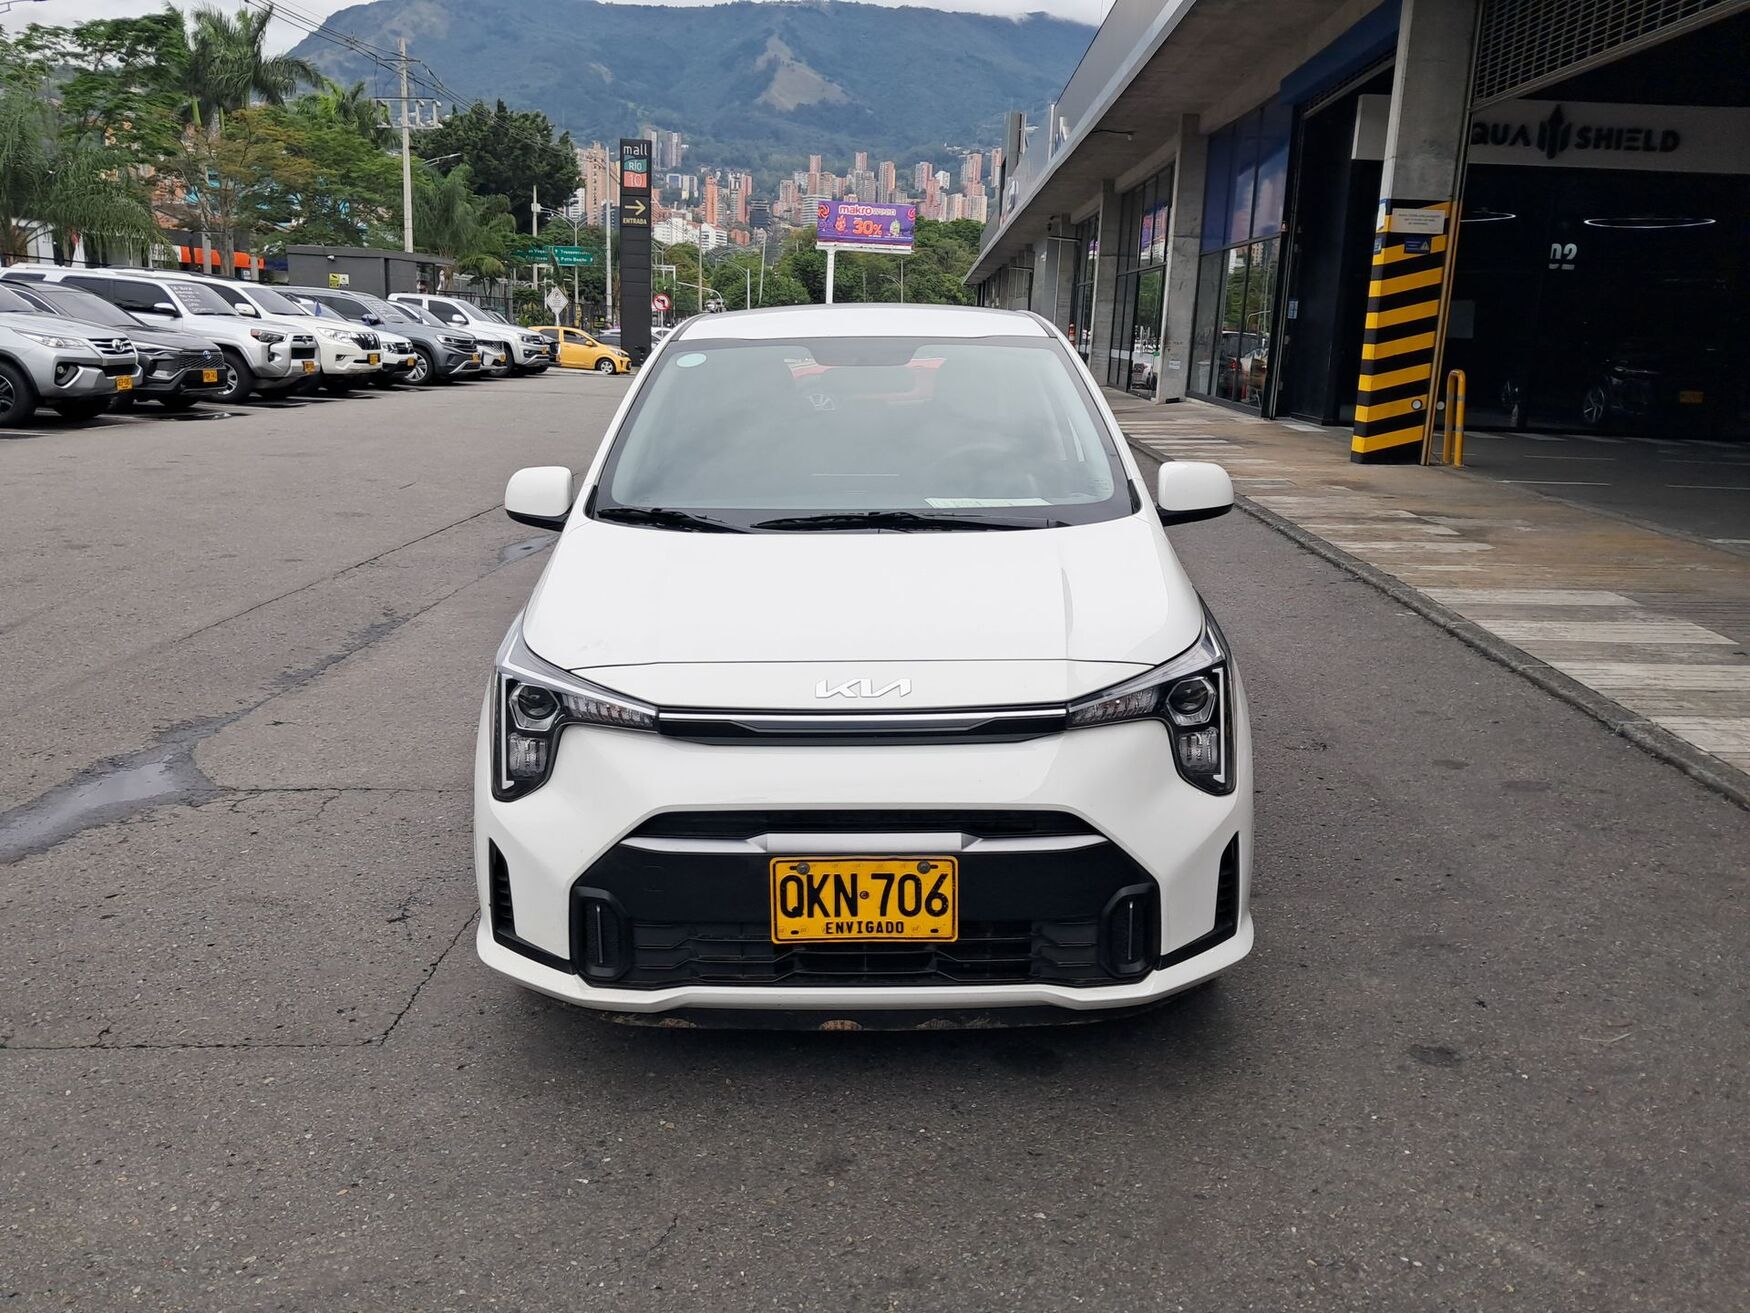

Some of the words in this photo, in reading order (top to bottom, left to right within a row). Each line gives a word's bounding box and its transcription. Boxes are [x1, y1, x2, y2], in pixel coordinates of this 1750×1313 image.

[1574, 125, 1681, 153] SHIELD
[623, 143, 648, 156] mall
[630, 174, 643, 187] 10
[623, 217, 647, 225] ENTRADA
[852, 219, 883, 235] 30%
[1549, 243, 1578, 270] 02
[815, 679, 912, 699] KIA
[779, 873, 858, 919] QKN
[871, 873, 950, 918] 706
[825, 920, 905, 935] ENVIGADO
